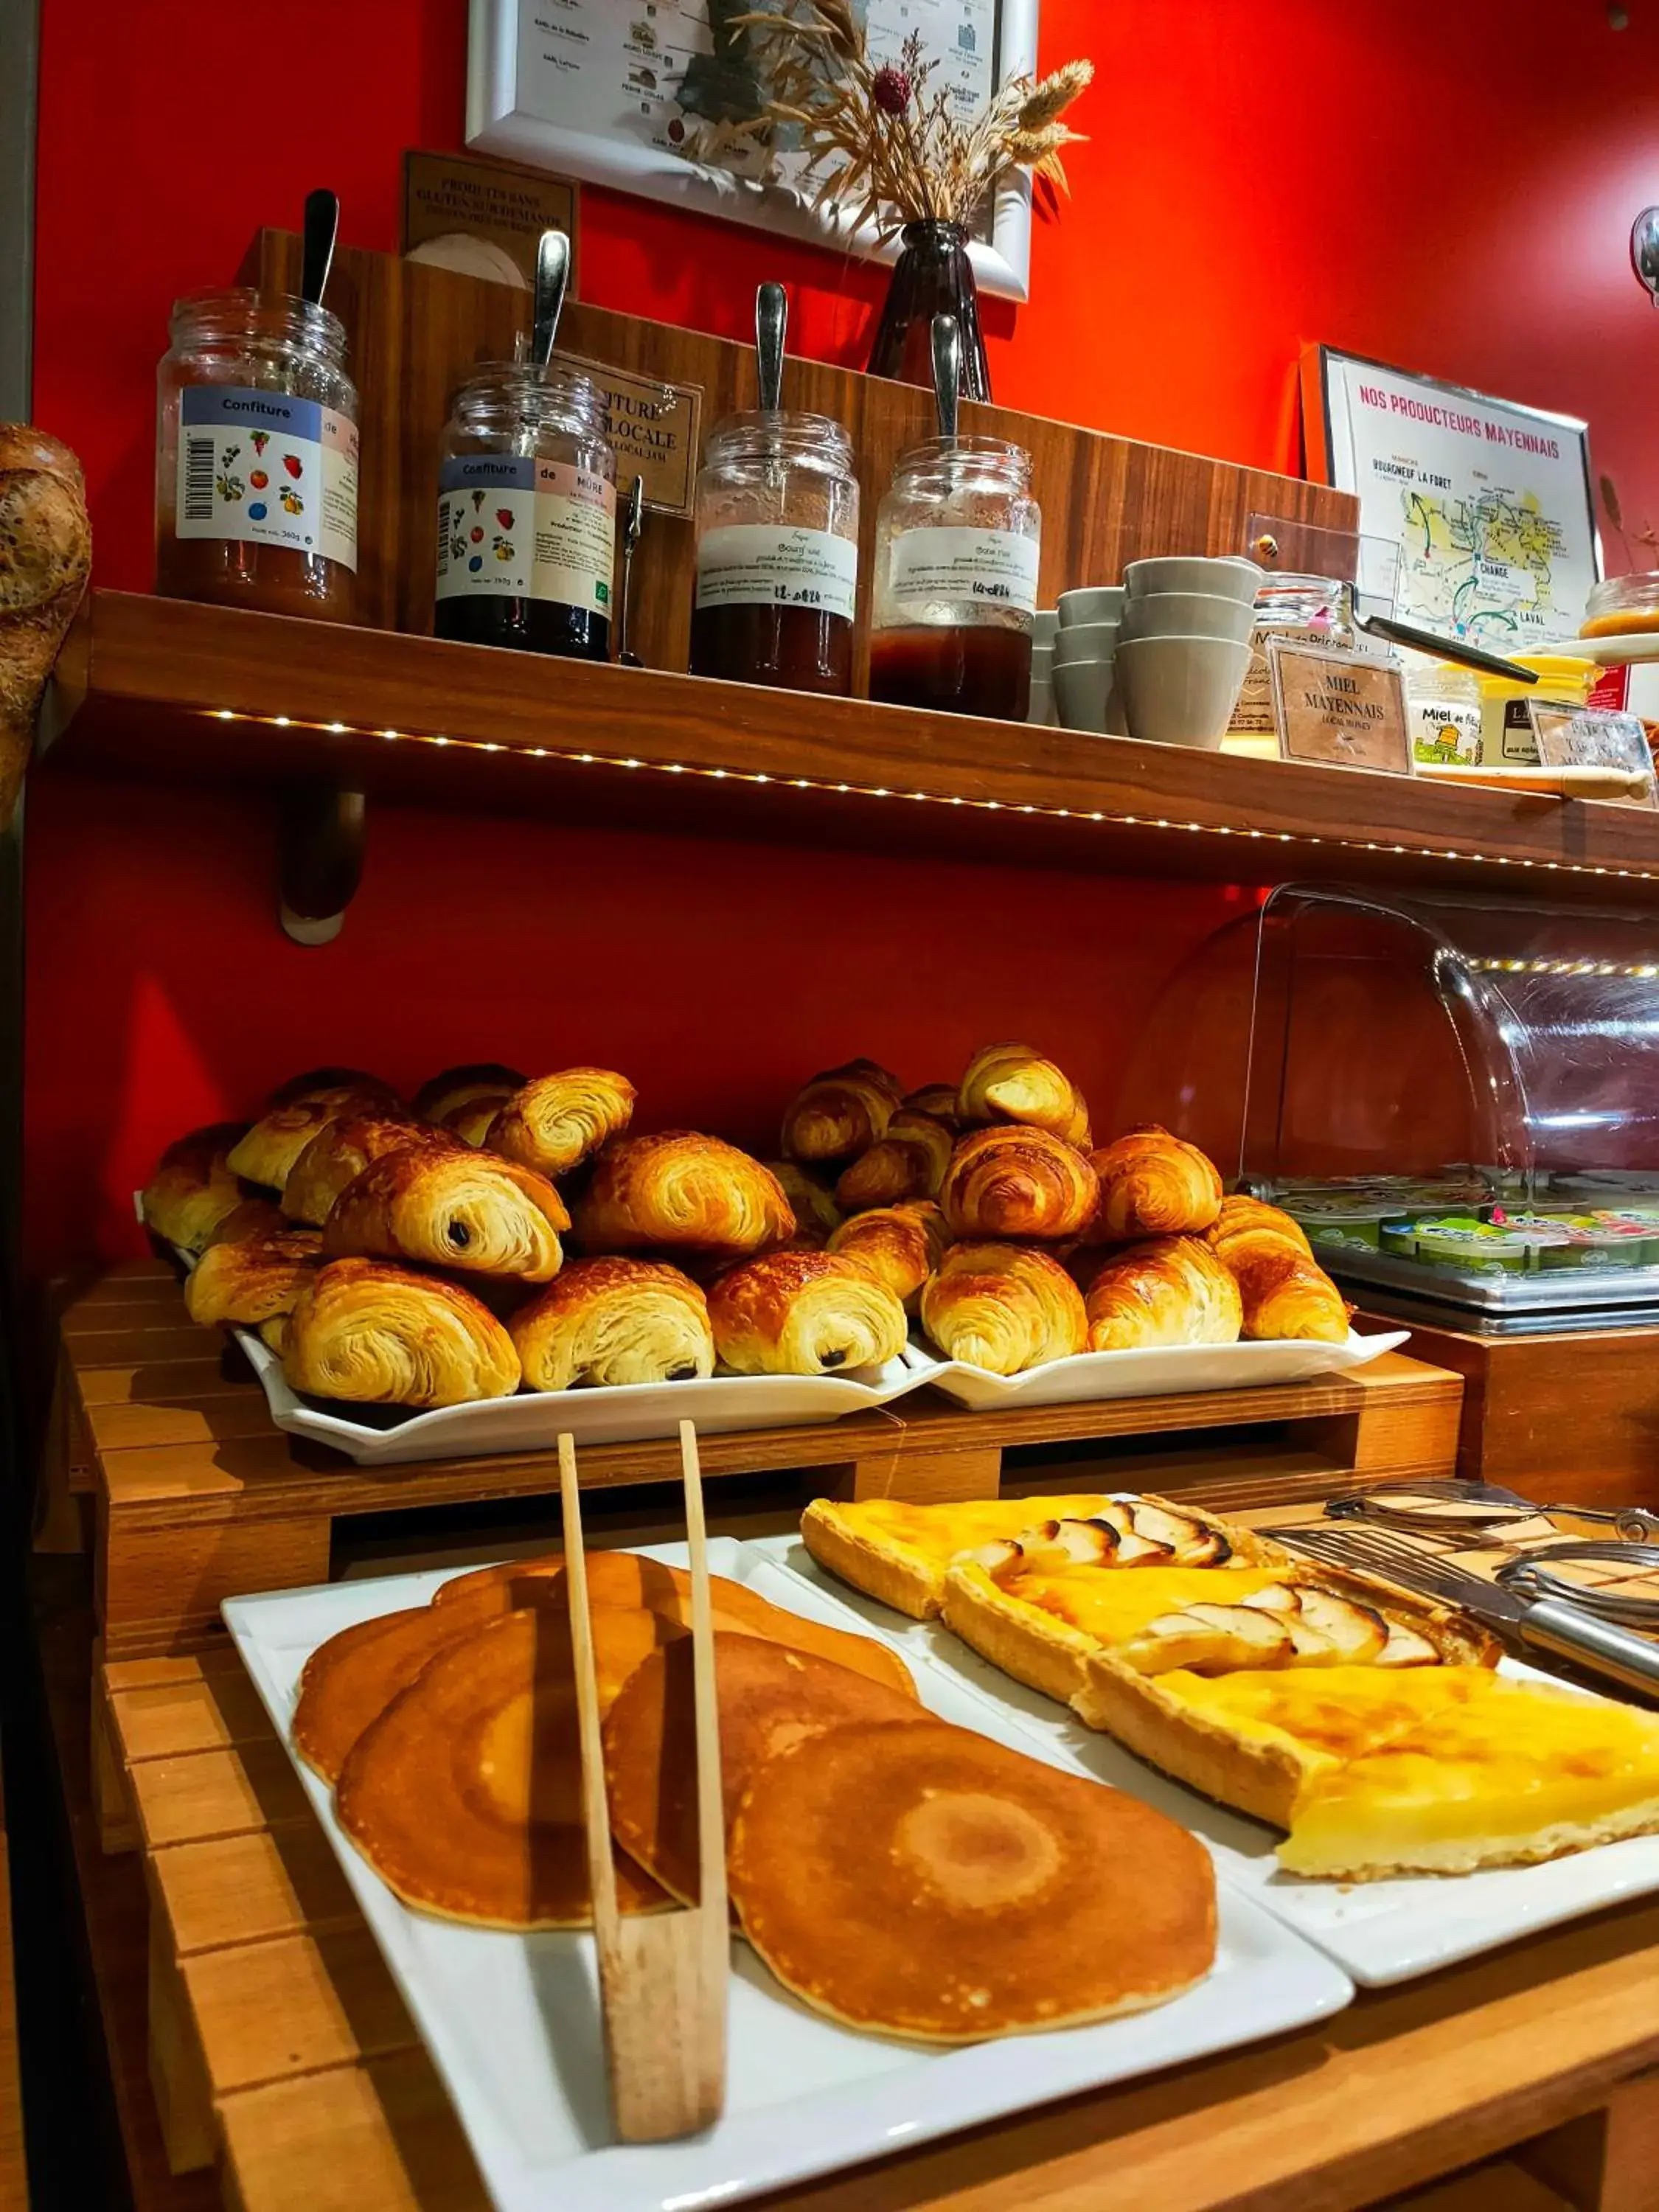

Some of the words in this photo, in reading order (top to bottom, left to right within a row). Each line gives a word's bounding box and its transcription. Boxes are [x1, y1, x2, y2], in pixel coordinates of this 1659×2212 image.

[223, 399, 291, 419] Confiture
[1360, 385, 1387, 409] NOS
[1391, 394, 1481, 437] PRODUCTEURS
[1484, 422, 1559, 459] MAYENNAIS
[609, 416, 676, 450] LOCALE
[463, 462, 517, 476] Confiture
[540, 467, 556, 480] de
[1417, 472, 1427, 484] LA
[1520, 612, 1545, 625] LAVAL
[1326, 675, 1360, 695] MIEL
[1305, 692, 1385, 720] MAYENNAIS
[1422, 707, 1451, 722] Miel
